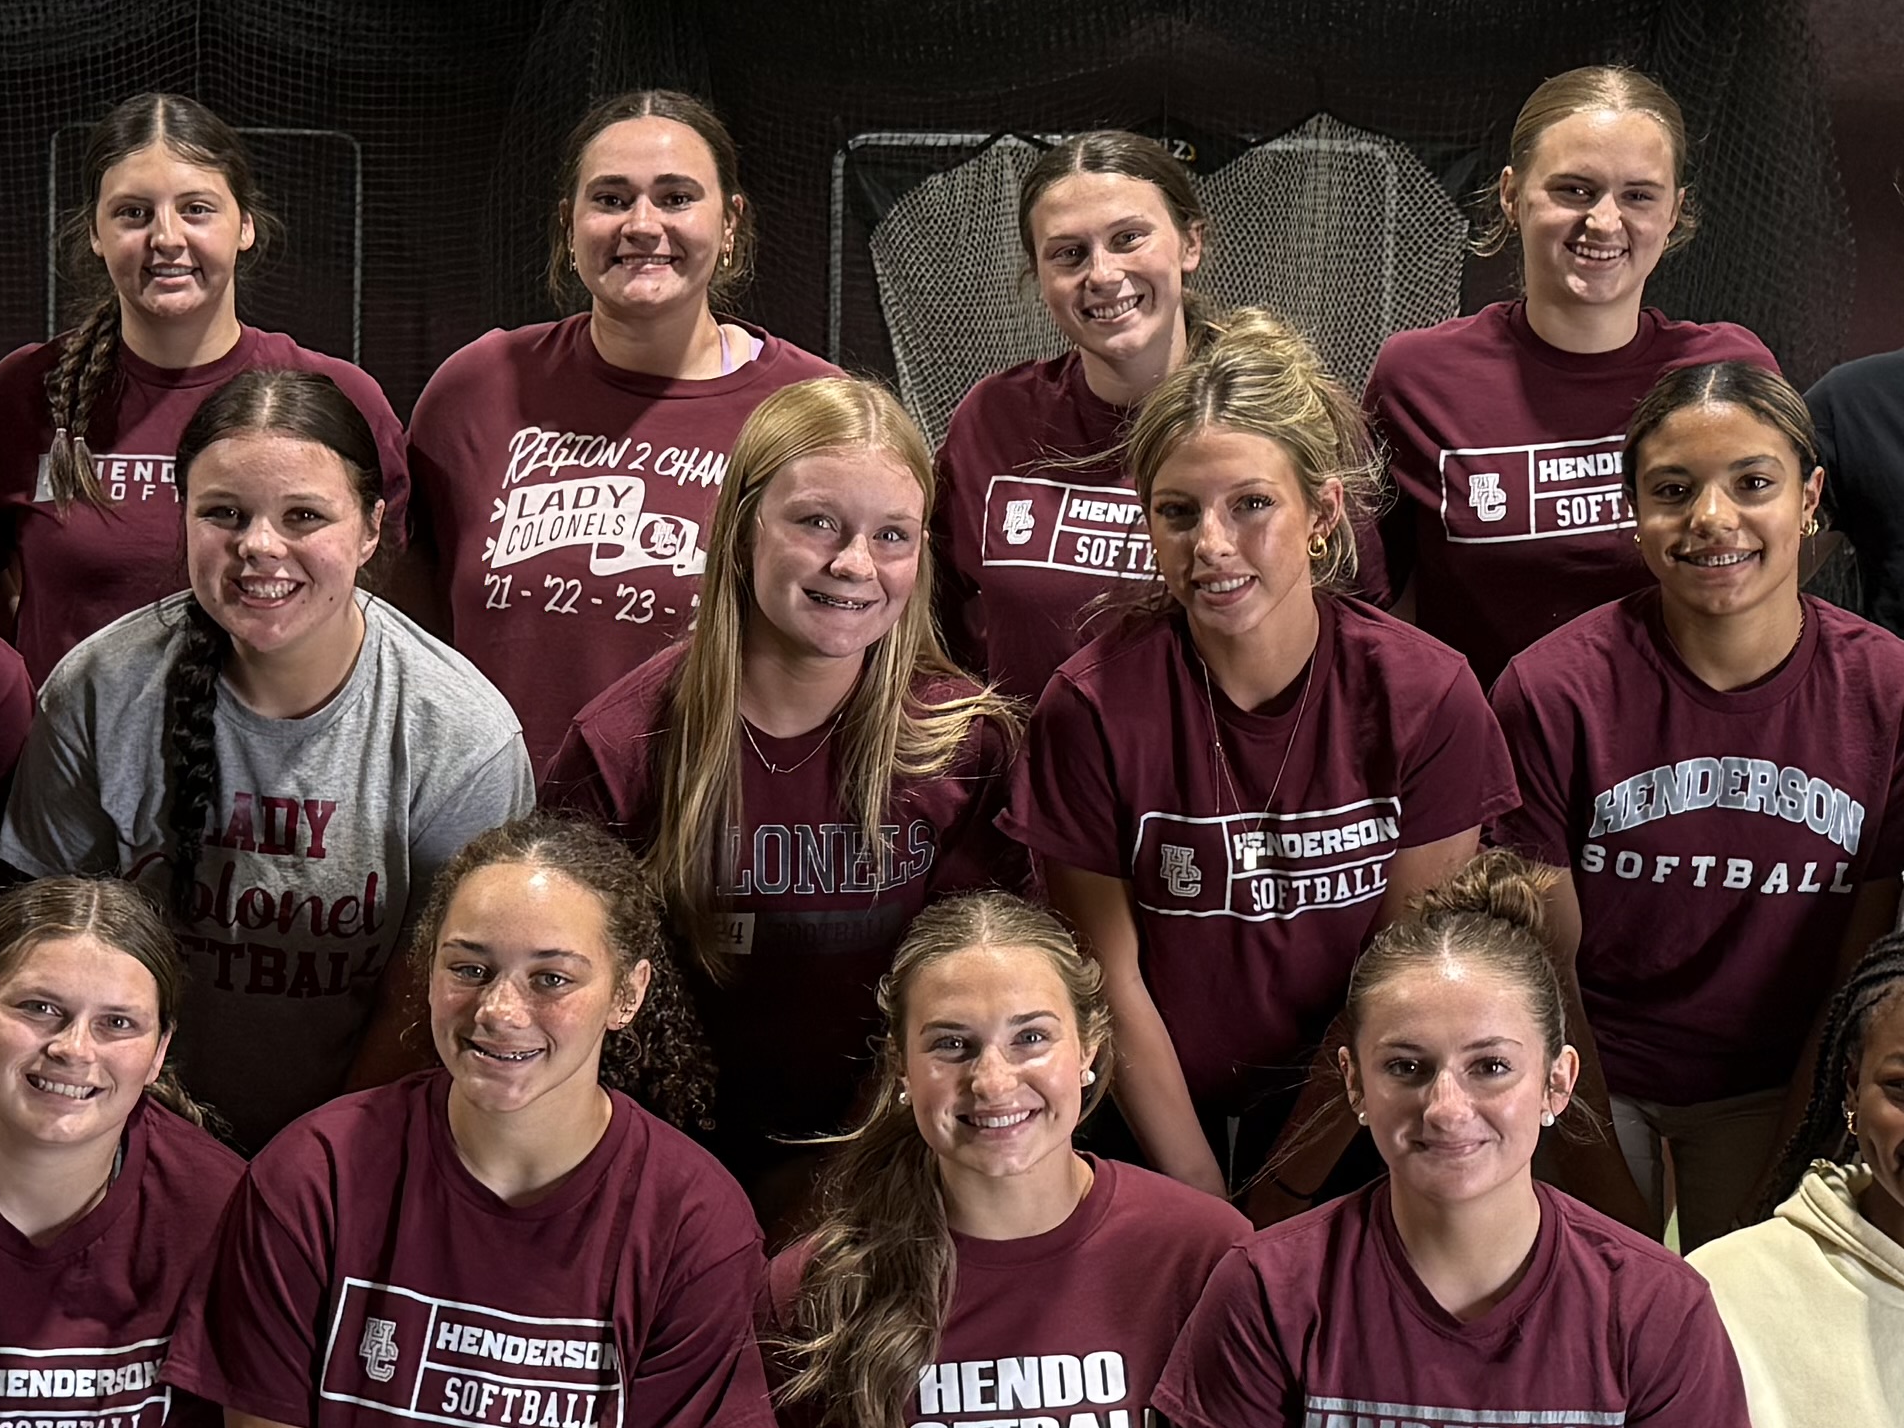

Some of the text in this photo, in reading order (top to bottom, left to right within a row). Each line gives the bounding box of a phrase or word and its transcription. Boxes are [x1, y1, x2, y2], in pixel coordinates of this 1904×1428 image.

[502, 426, 632, 489] REGION
[628, 442, 652, 471] 2
[517, 484, 634, 520] LADY
[1555, 490, 1635, 528] SOFT
[506, 513, 626, 556] COLONELS
[483, 573, 513, 610] '21
[544, 574, 583, 614] '22
[615, 583, 656, 624] '23
[1587, 756, 1866, 857] HENDERSON
[716, 818, 937, 897] LONELS
[1232, 816, 1401, 861] HENDERSON
[1250, 863, 1388, 913] SOFTBALL
[1580, 843, 1854, 895] SOFTBALL
[358, 1317, 399, 1383] HC
[436, 1321, 619, 1371] HENDERSON
[918, 1351, 1127, 1415] HENDO
